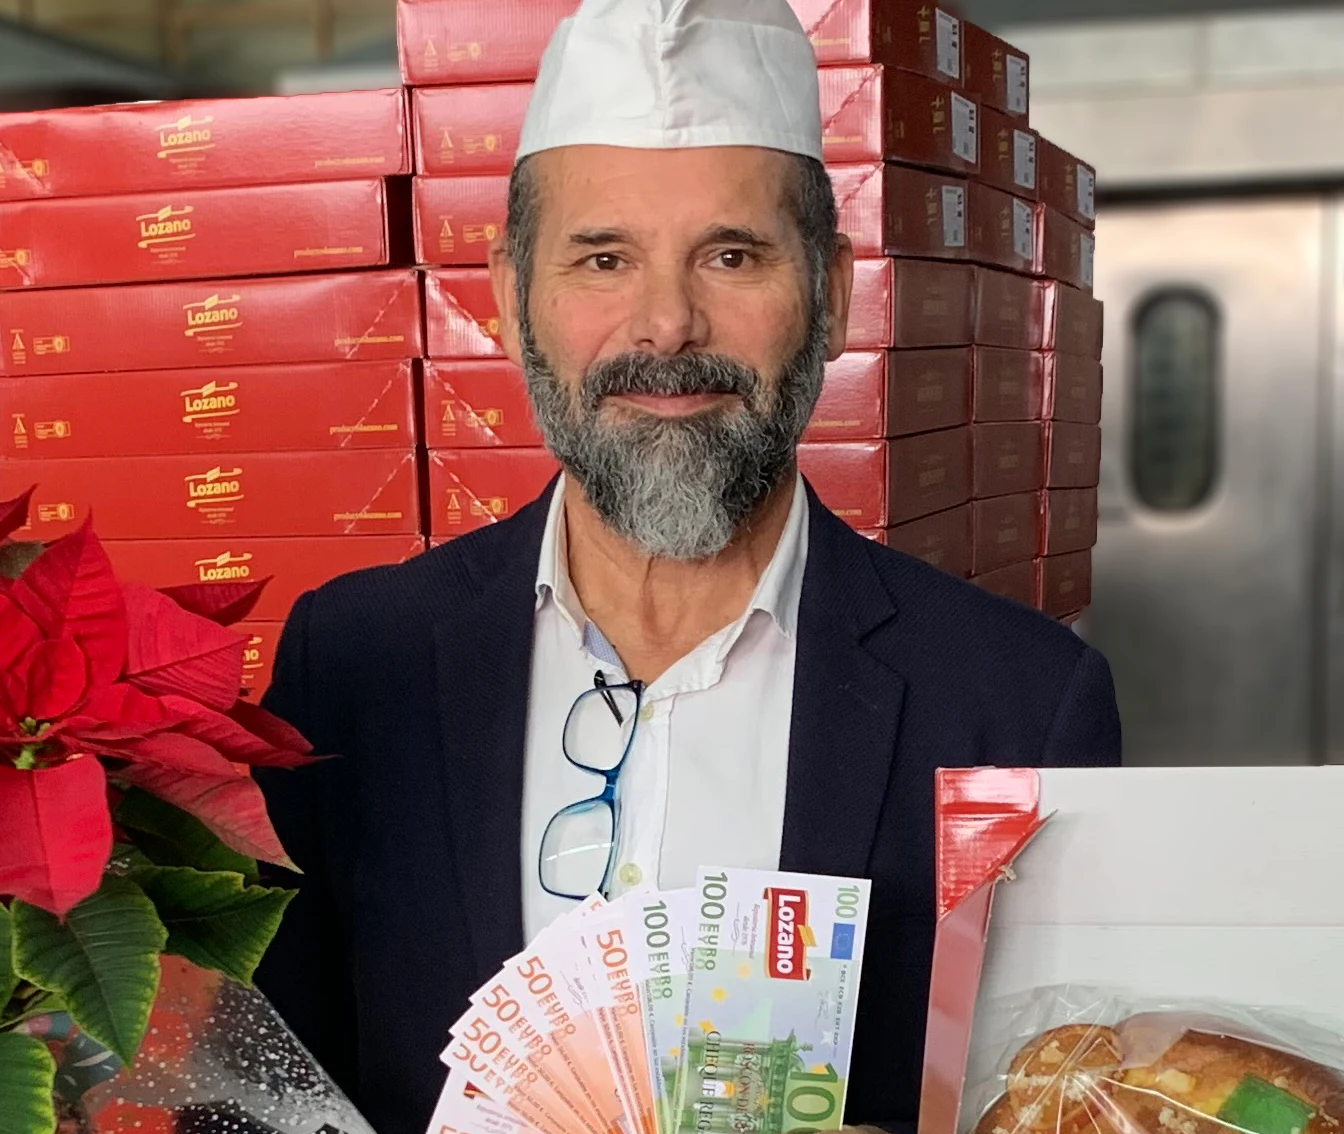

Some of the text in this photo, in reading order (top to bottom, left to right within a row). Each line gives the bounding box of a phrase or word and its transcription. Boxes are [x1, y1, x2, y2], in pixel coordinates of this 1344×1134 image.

[160, 128, 211, 147] Lozano
[140, 218, 191, 237] Lozano
[187, 307, 238, 325] Lozano
[185, 395, 236, 412] Lozano
[189, 479, 240, 497] Lozano
[199, 564, 250, 582] Lozano
[701, 871, 728, 971] 100 EURO
[776, 894, 801, 974] Lozano
[835, 885, 860, 919] 100
[596, 929, 638, 1014] 50 EURO
[643, 900, 673, 999] 100 EURO
[482, 983, 521, 1022] 50
[515, 1016, 553, 1056] EURO
[517, 956, 577, 1035] 50 EURO
[463, 1017, 538, 1083] 50 EURO
[698, 1030, 721, 1096] CHEQUE
[784, 1061, 839, 1134] 10
